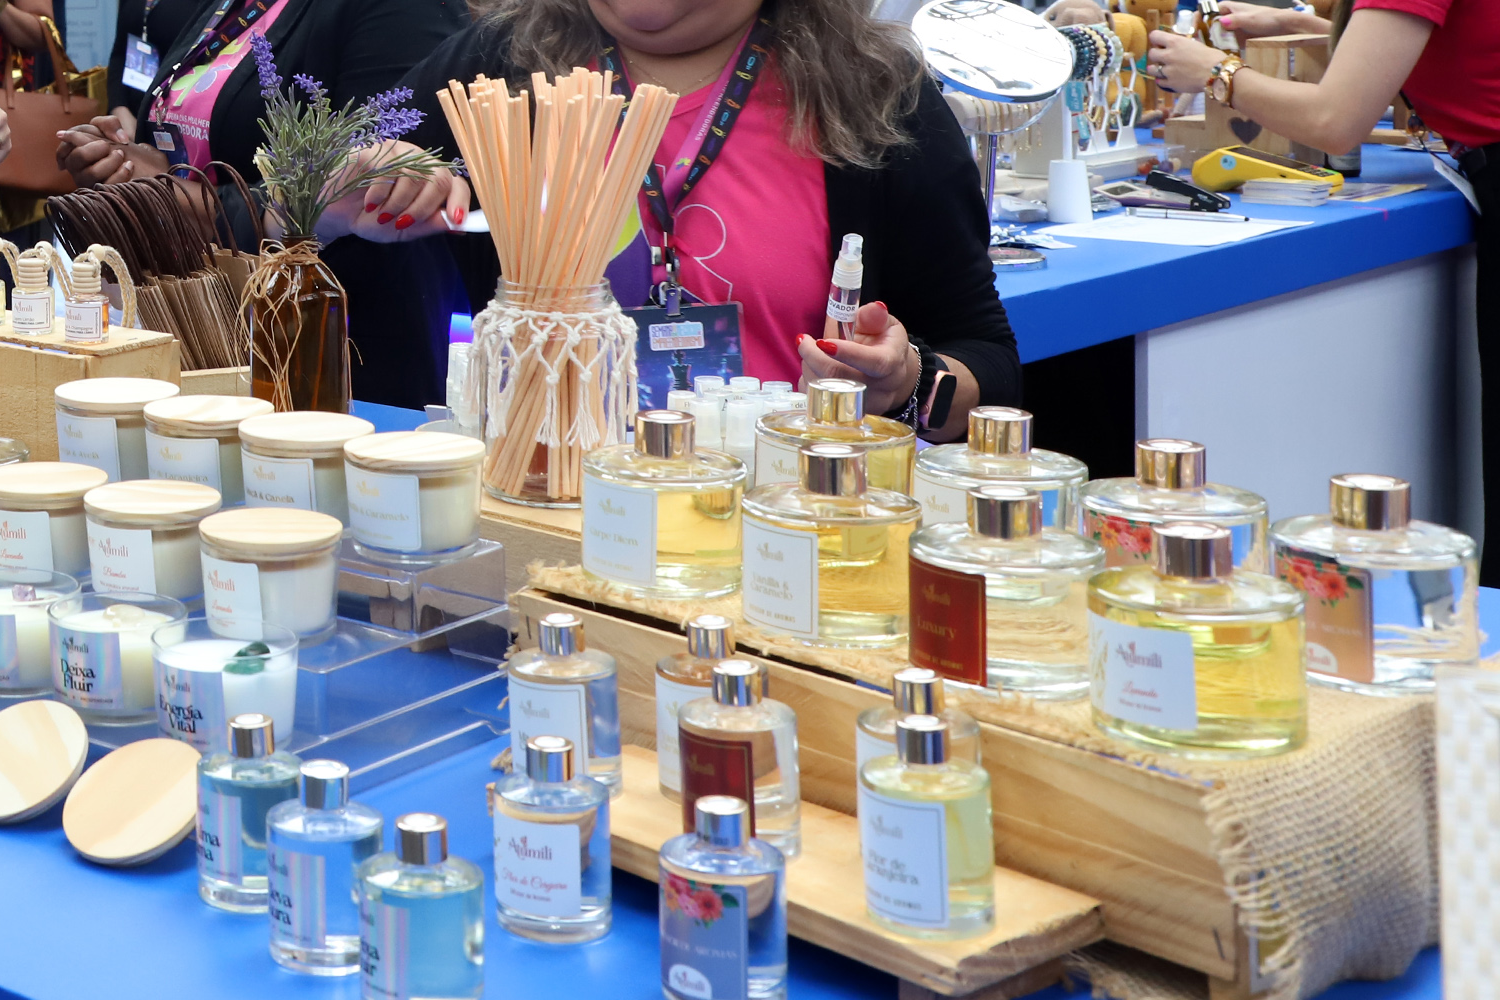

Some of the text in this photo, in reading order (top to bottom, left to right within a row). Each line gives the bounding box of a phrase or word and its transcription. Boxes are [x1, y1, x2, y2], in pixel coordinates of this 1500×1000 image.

[60, 659, 97, 679] Deixa
[63, 674, 94, 693] Fluir
[168, 713, 197, 734] Vital
